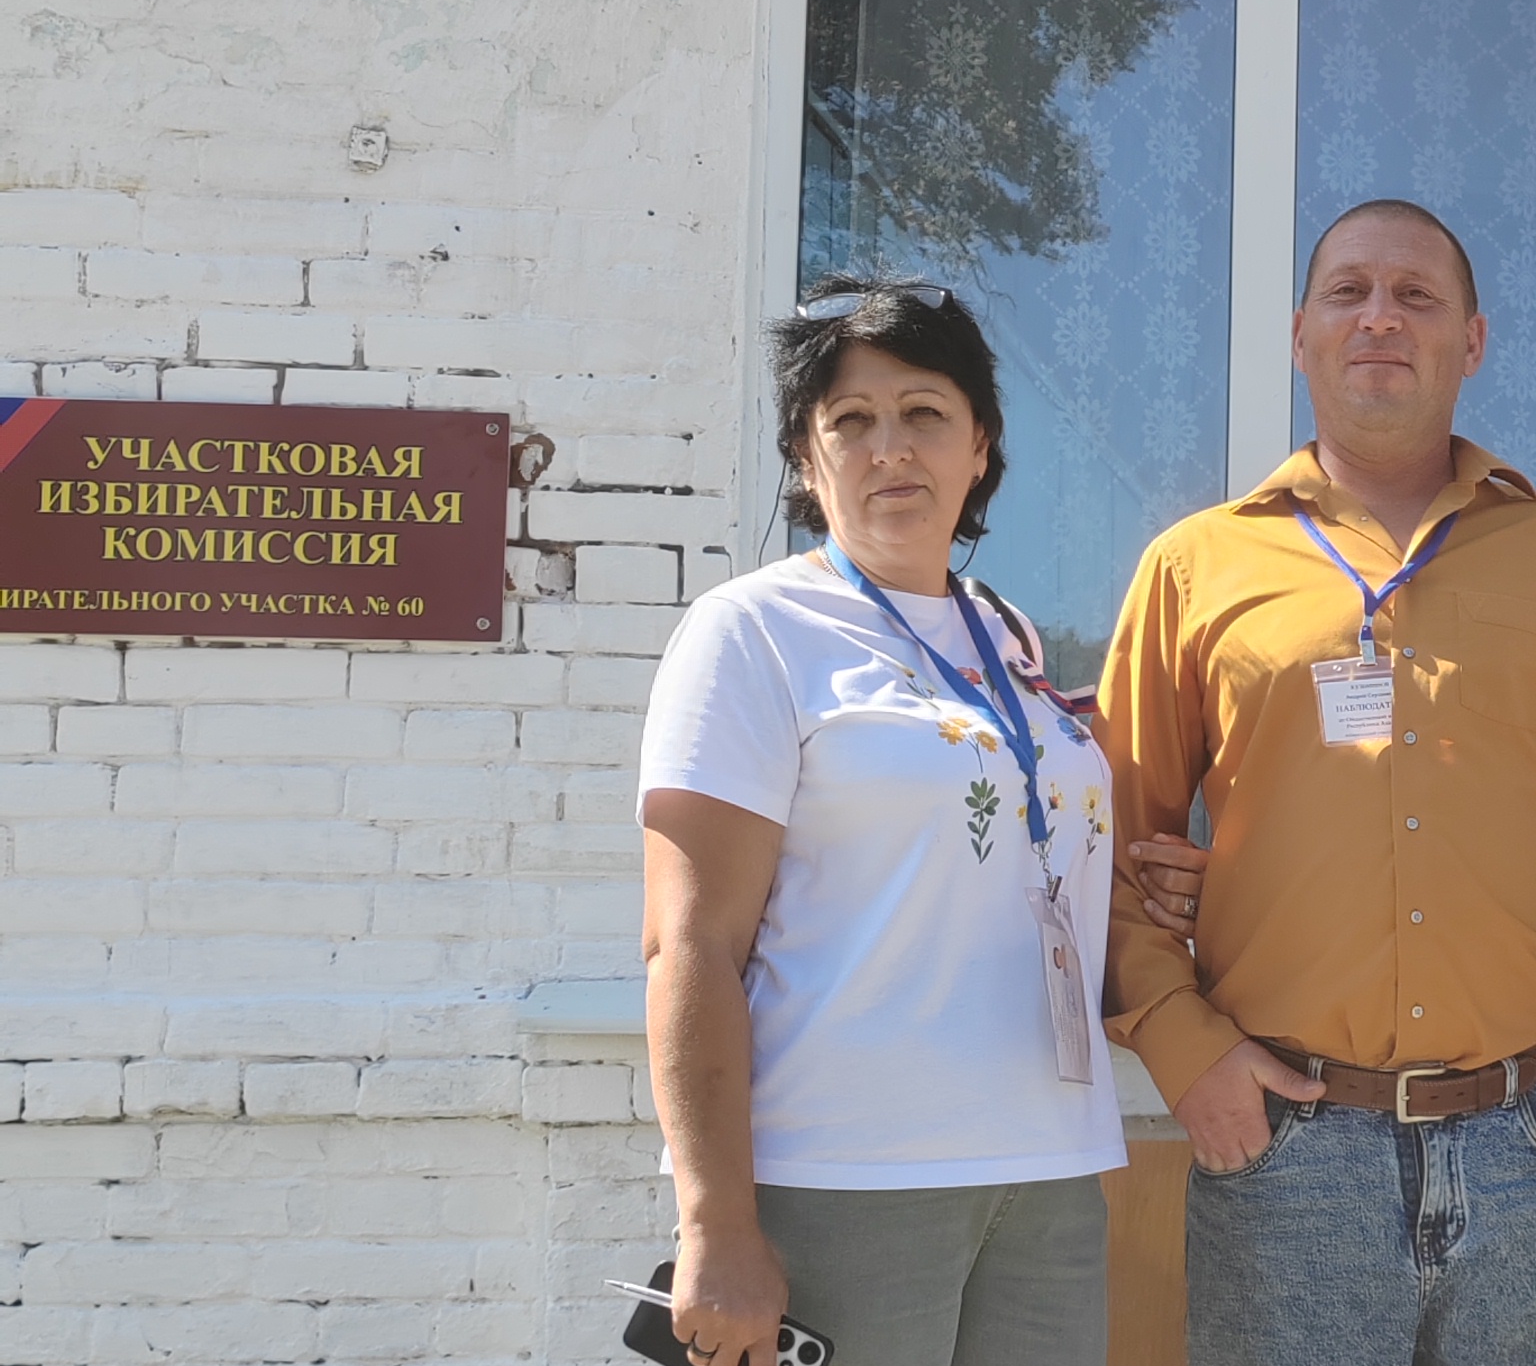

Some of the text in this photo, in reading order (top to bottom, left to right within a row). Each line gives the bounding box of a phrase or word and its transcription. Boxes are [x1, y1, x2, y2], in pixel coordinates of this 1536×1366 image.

[82, 436, 424, 479] УЧАСТКОВАЯ
[37, 480, 463, 524] ИЗБИРАТЕЛЬНАЯ
[101, 527, 399, 566] КОМИССИЯ
[0, 589, 424, 617] ИРАТЕЛЬНОГО УЧАСТКА № 60
